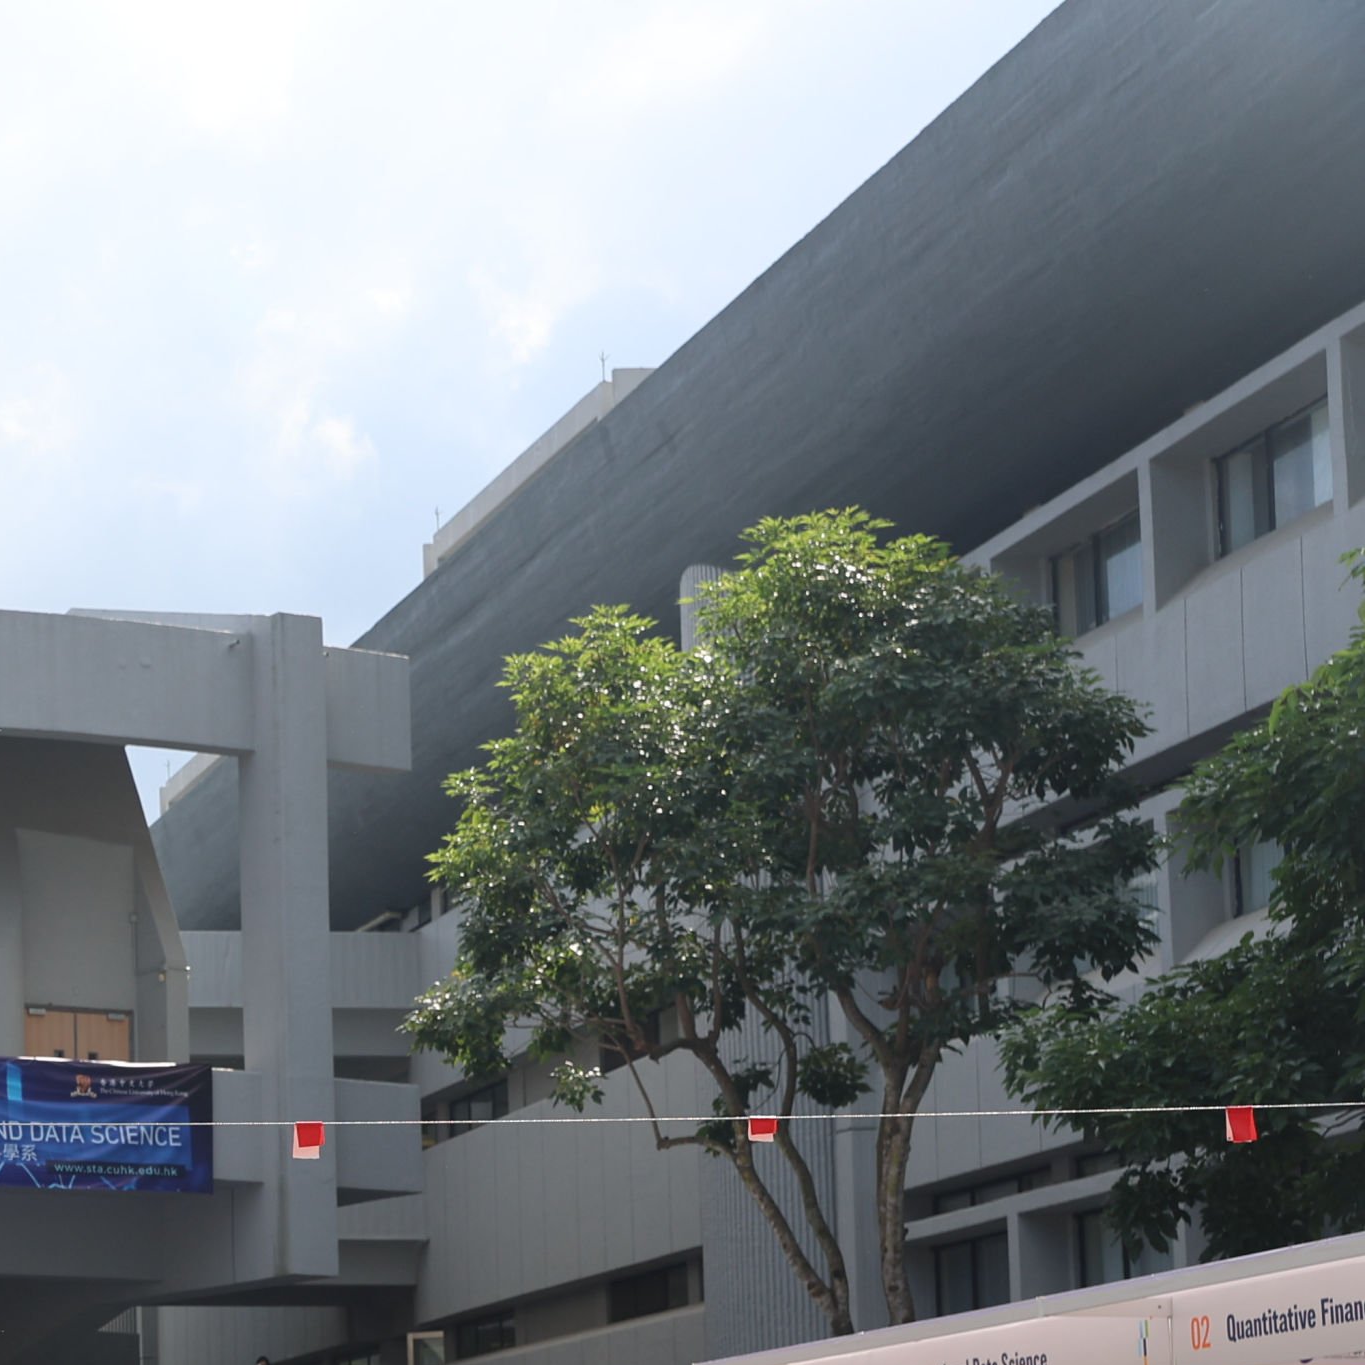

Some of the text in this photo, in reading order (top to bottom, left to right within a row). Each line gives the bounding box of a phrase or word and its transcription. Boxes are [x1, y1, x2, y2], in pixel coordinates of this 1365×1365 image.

[30, 1121, 85, 1144] DATA
[90, 1124, 182, 1147] SCIENCE
[54, 1162, 178, 1177] www.sta.cuhk.edu.hk
[1190, 1315, 1212, 1350] 02
[1226, 1303, 1317, 1343] Quantitative
